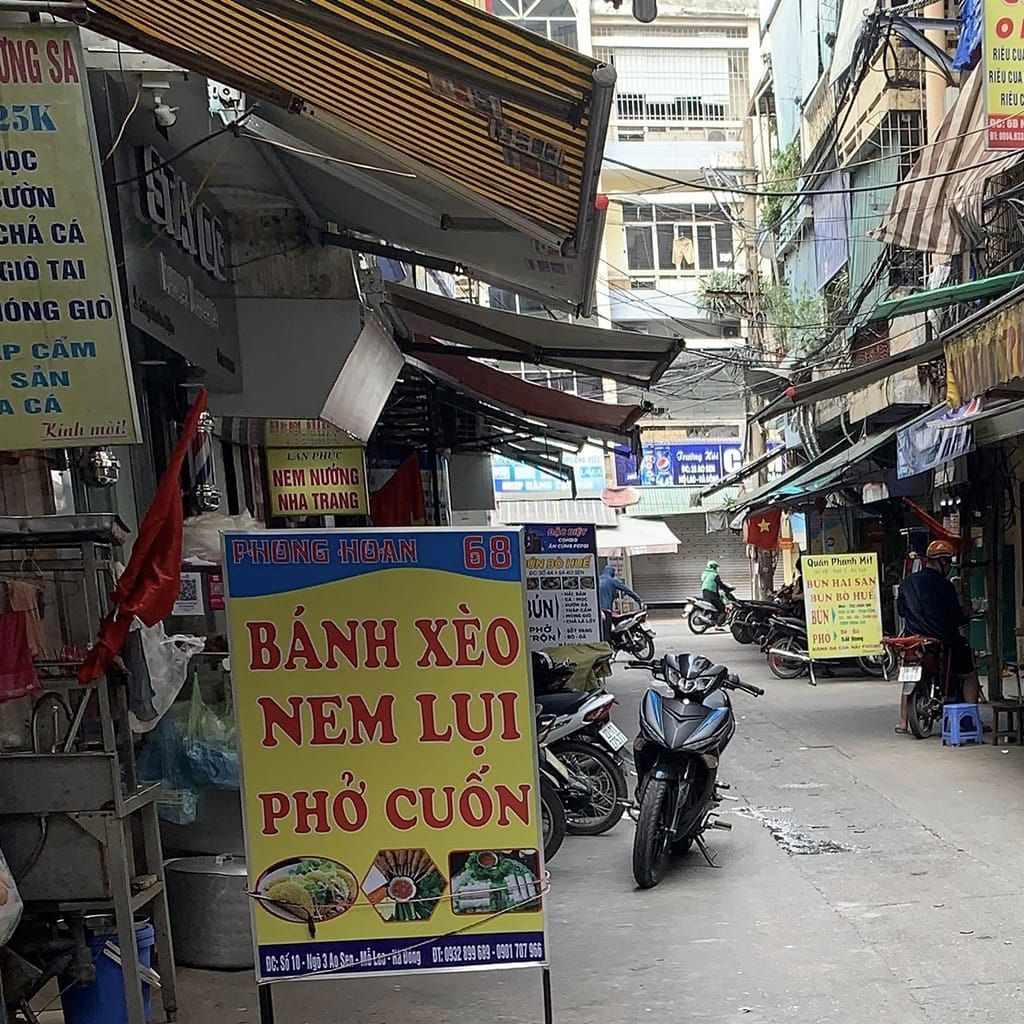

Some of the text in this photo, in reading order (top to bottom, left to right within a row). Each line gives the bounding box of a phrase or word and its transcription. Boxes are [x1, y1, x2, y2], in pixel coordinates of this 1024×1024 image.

[46, 39, 79, 84] SA
[1008, 71, 1022, 84] CUA
[51, 219, 85, 244] CÁ
[46, 259, 86, 280] TAI
[69, 295, 113, 320] GIÒ
[10, 365, 70, 388] SẢN
[24, 394, 62, 415] CÁ
[272, 463, 360, 488] NEM NƯỚNG
[277, 492, 360, 512] NHA TRANG
[232, 539, 330, 565] PHONG
[462, 535, 513, 570] 68
[245, 602, 521, 671] BÁNH XÈO
[256, 691, 522, 758] NEM LỤI
[258, 763, 532, 836] PHỞ CUỐN
[280, 951, 290, 971] Số
[291, 954, 301, 971] 10
[306, 952, 321, 972] Ngõ
[323, 952, 328, 969] 3
[329, 951, 339, 968] Ao
[340, 950, 354, 968] Sen
[432, 945, 443, 963] ĐT:
[444, 945, 462, 963] 0932
[463, 944, 477, 961] 899
[496, 943, 513, 960] 0901
[514, 942, 528, 959] 707
